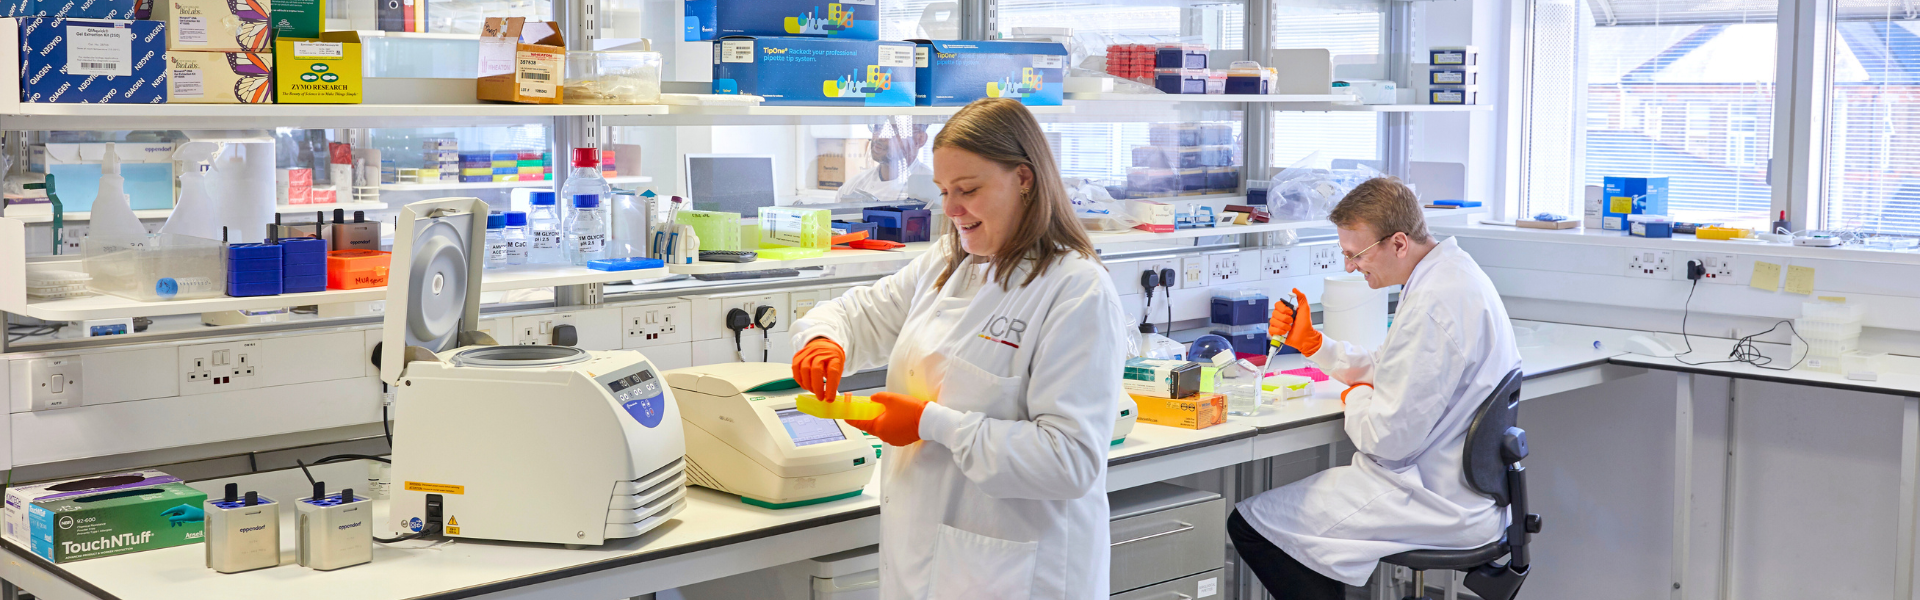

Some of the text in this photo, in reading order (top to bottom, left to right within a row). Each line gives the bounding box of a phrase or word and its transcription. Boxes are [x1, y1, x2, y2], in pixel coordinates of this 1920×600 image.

[144, 22, 164, 43] QIAGEN
[40, 36, 62, 56] QIAGEN
[134, 50, 154, 70] QIAGEN
[30, 64, 52, 85] QIAGEN
[49, 82, 72, 102] QIAGEN
[124, 78, 146, 98] QIAGEN
[982, 314, 1027, 342] ICR
[240, 524, 266, 533] eppendorf
[338, 521, 361, 530] eppendorf
